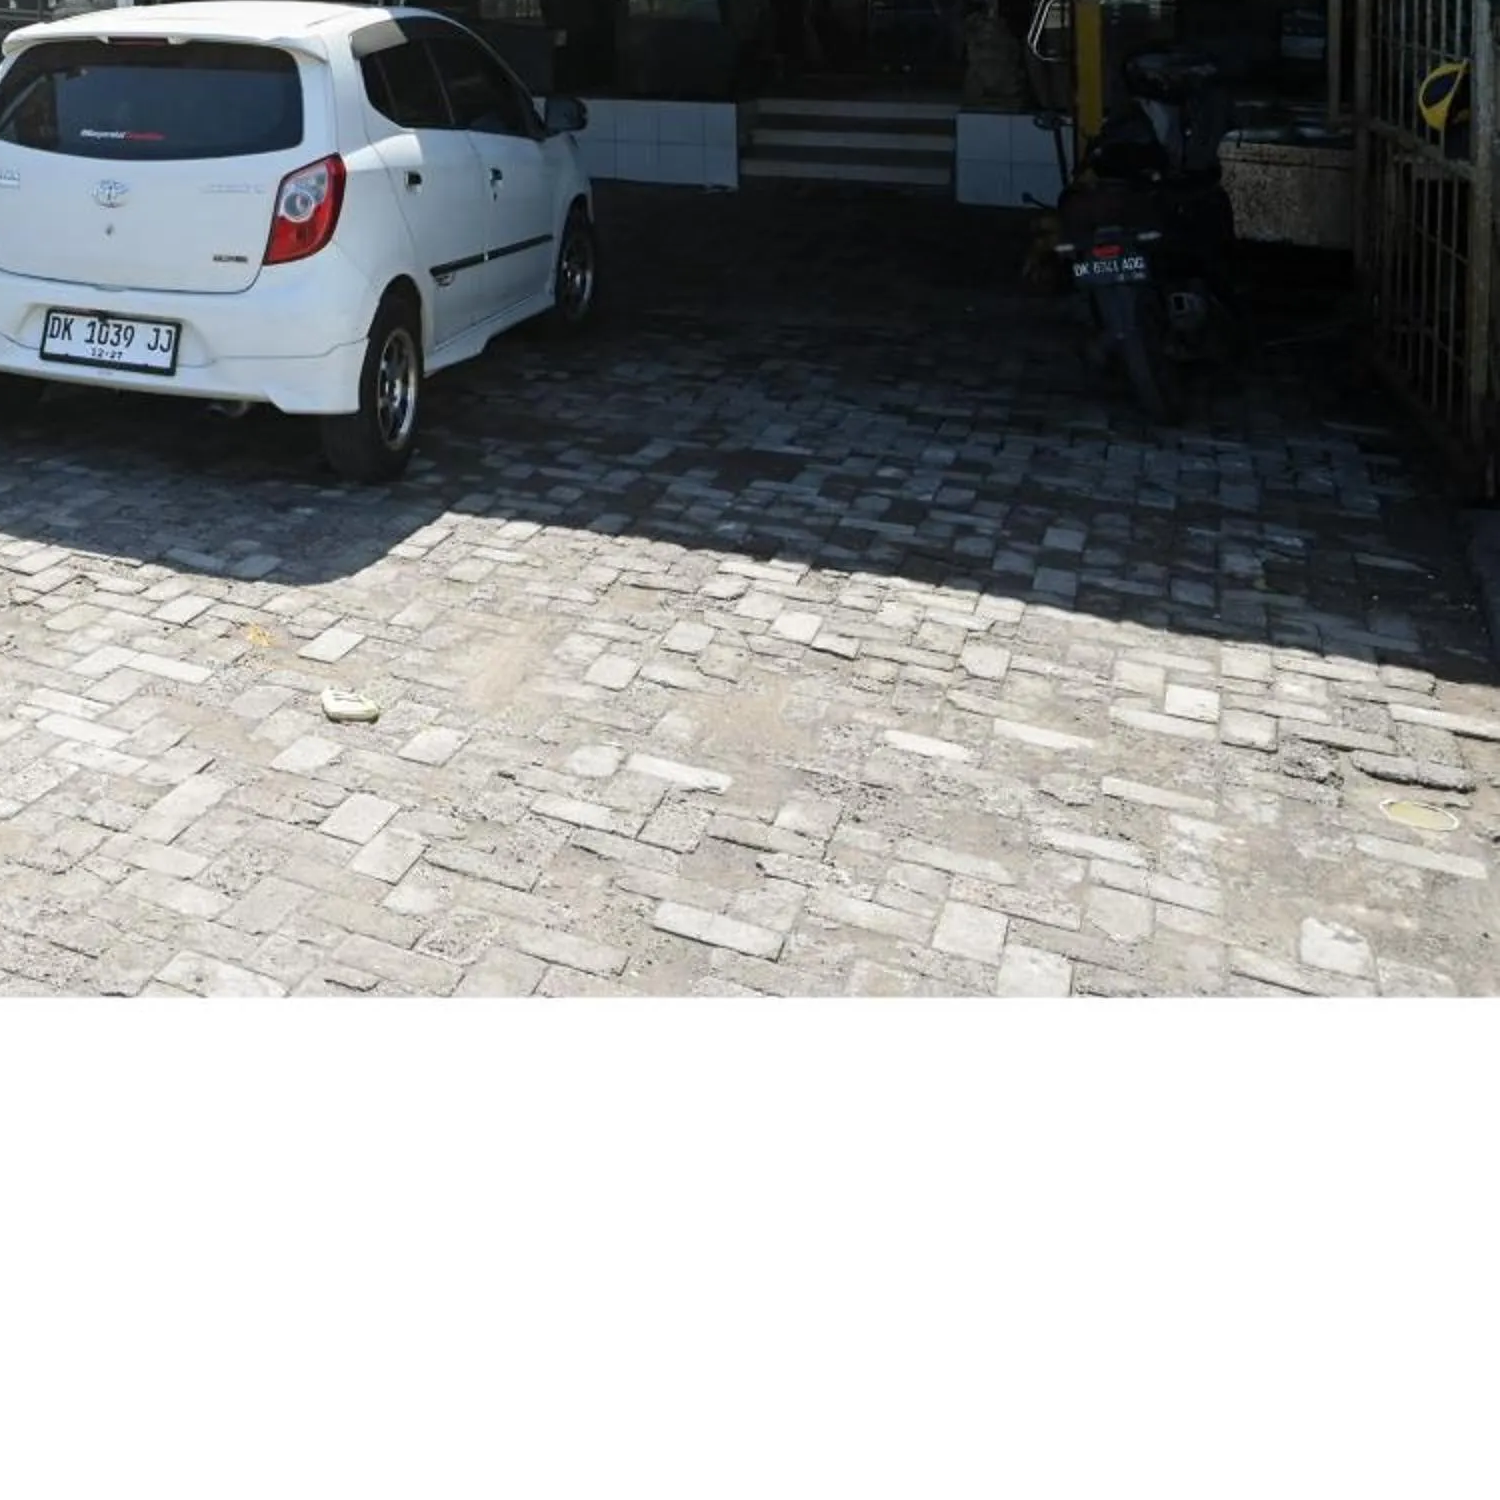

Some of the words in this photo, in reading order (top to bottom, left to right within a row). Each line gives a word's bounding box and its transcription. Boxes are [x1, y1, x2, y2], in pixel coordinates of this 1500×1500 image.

[49, 316, 75, 341] DK
[84, 320, 136, 349] 1039
[147, 326, 174, 354] JJ
